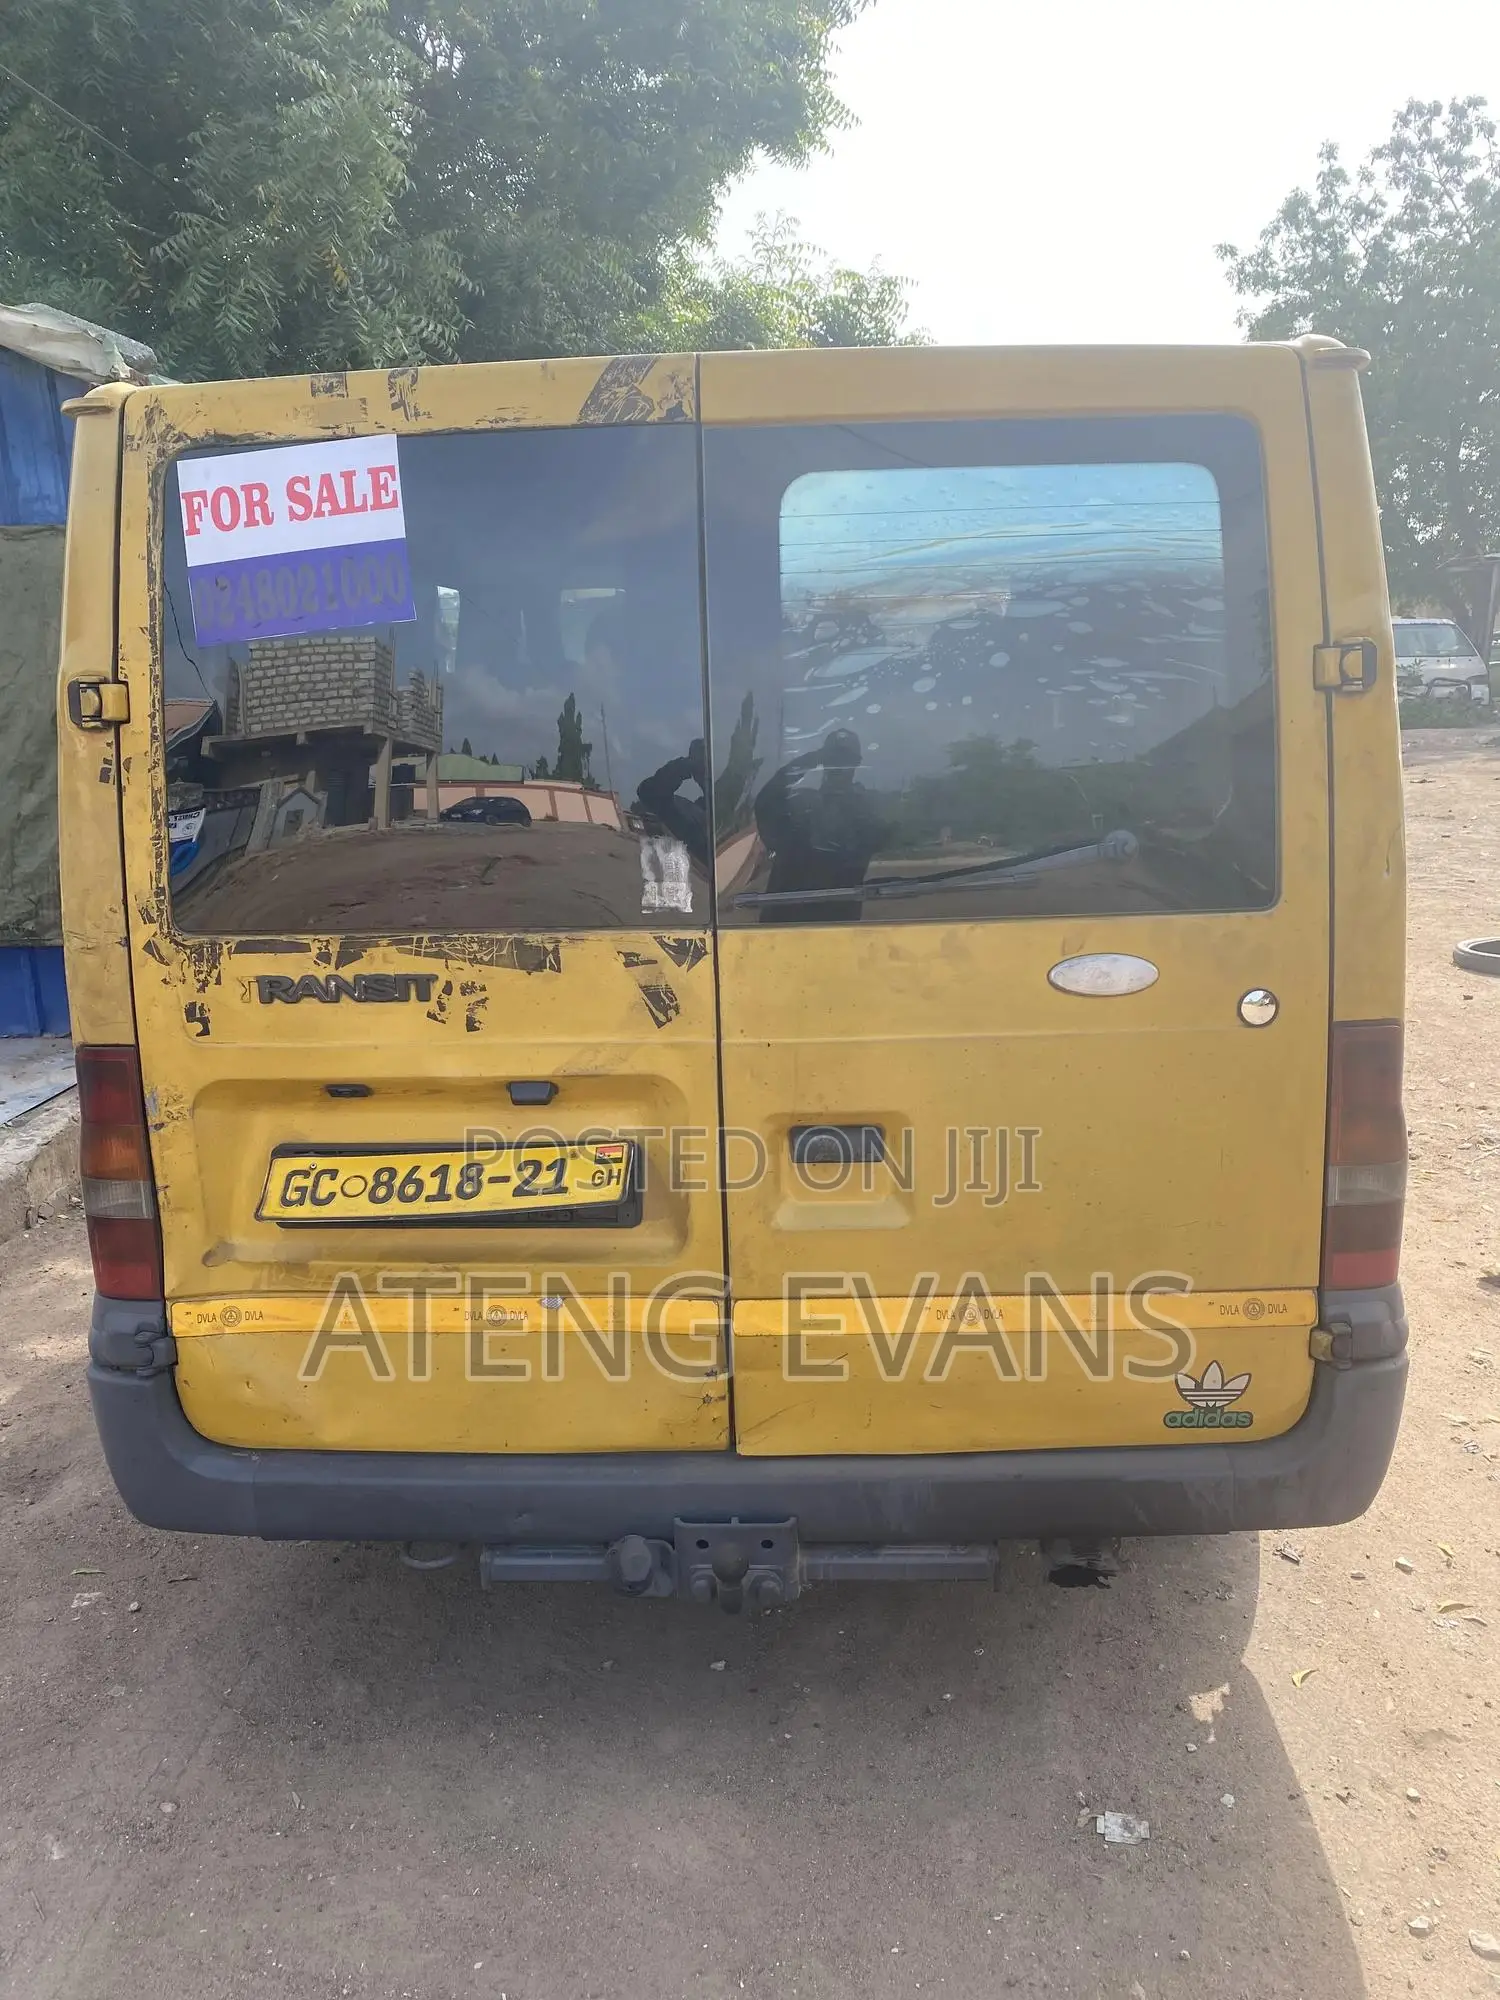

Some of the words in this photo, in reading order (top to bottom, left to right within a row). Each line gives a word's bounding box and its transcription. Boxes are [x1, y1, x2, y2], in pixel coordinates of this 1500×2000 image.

[181, 482, 274, 536] FOR
[286, 465, 399, 521] SALE
[280, 1168, 339, 1207] GC
[367, 1158, 570, 1205] 8618-21
[591, 1167, 622, 1187] GH
[197, 1313, 217, 1324] DVLA
[245, 1310, 264, 1321] DVLA
[465, 1310, 483, 1321] DVLA
[510, 1310, 528, 1321] DVLA
[936, 1309, 956, 1320] DVLA
[984, 1308, 1004, 1319] DVLA
[1220, 1304, 1240, 1316] DVLA
[1267, 1303, 1288, 1314] DVLA
[1163, 1408, 1253, 1428] adidas
